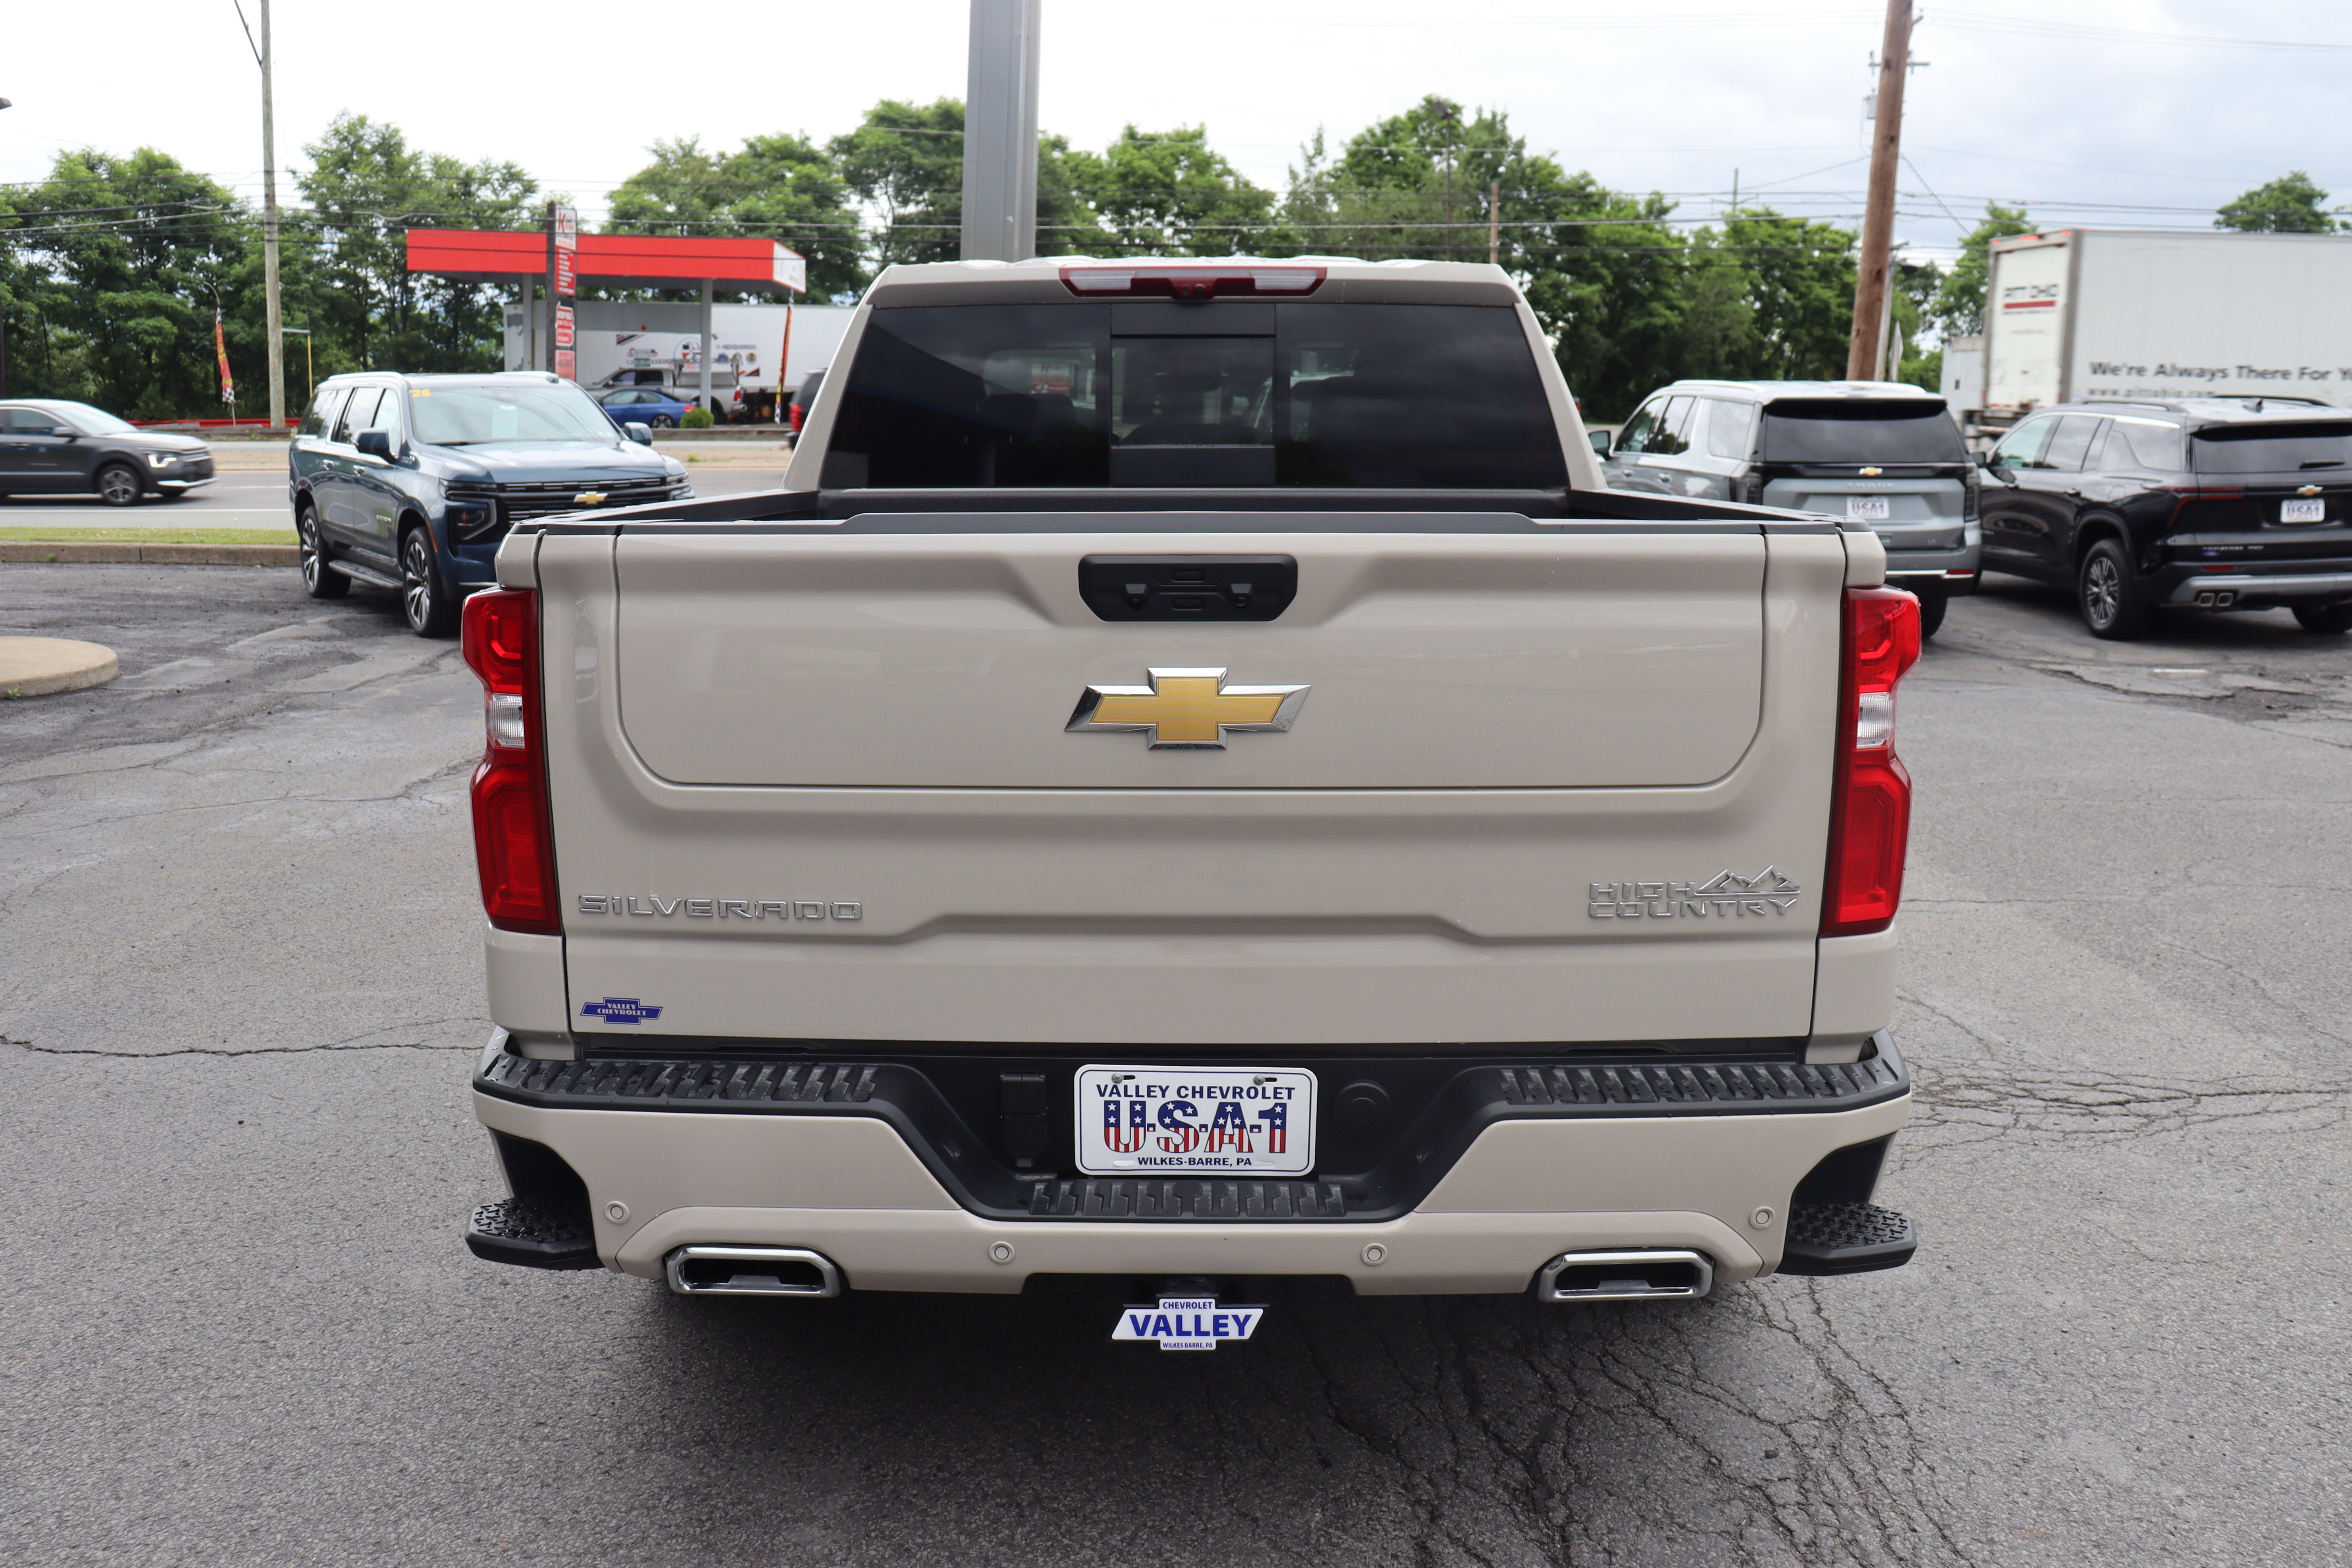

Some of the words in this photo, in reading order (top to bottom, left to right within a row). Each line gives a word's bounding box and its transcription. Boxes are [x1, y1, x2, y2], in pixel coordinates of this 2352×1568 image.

[2089, 362, 2148, 376] We're
[2152, 363, 2228, 382] Always
[2235, 365, 2291, 380] There
[2298, 366, 2332, 380] For
[1590, 880, 1696, 899] HIGH
[579, 894, 863, 920] SILVERADO
[1588, 898, 1797, 917] COUNTRY
[597, 1008, 646, 1016] CHEVROLET
[1096, 1084, 1170, 1098] VALLEY
[1176, 1085, 1295, 1100] CHEVROLET
[1137, 1157, 1233, 1167] WILKES-BARRE,
[1236, 1158, 1252, 1166] PA
[1129, 1314, 1252, 1336] VALLEY
